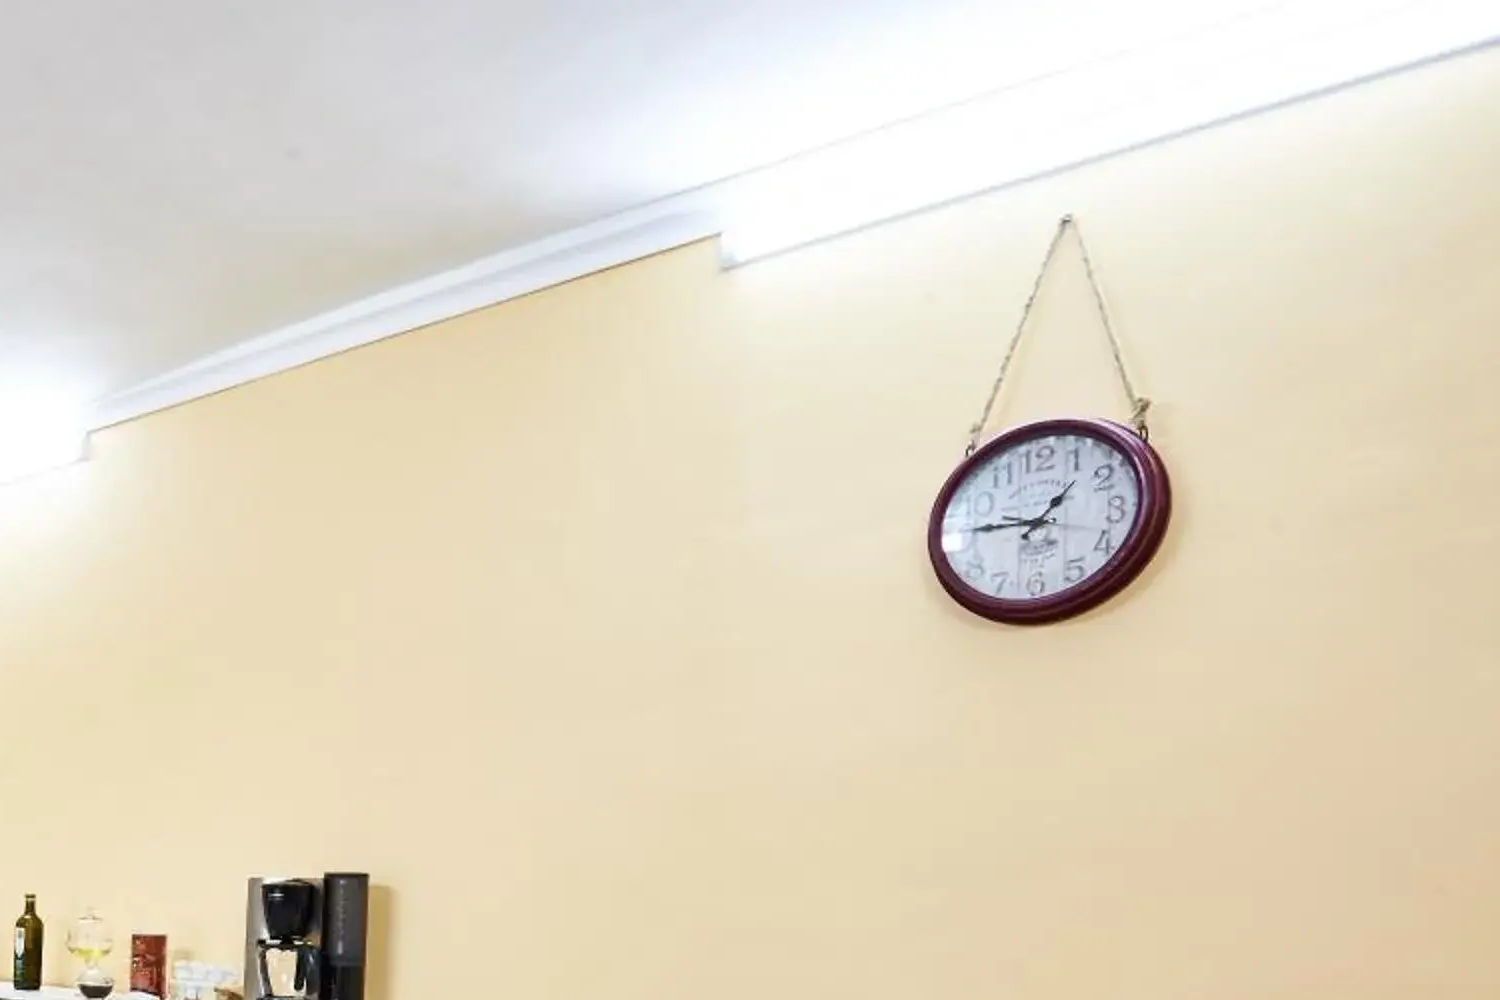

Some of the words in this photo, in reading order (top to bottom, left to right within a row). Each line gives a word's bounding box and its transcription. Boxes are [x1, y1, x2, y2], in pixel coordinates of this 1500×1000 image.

[1024, 445, 1056, 474] 12
[1067, 447, 1080, 472] 1
[1094, 463, 1115, 492] 2
[1106, 495, 1125, 523] 3
[1093, 529, 1114, 555] 4
[1064, 555, 1085, 582] 5
[991, 571, 1009, 595] 7
[1026, 571, 1046, 596] 6
